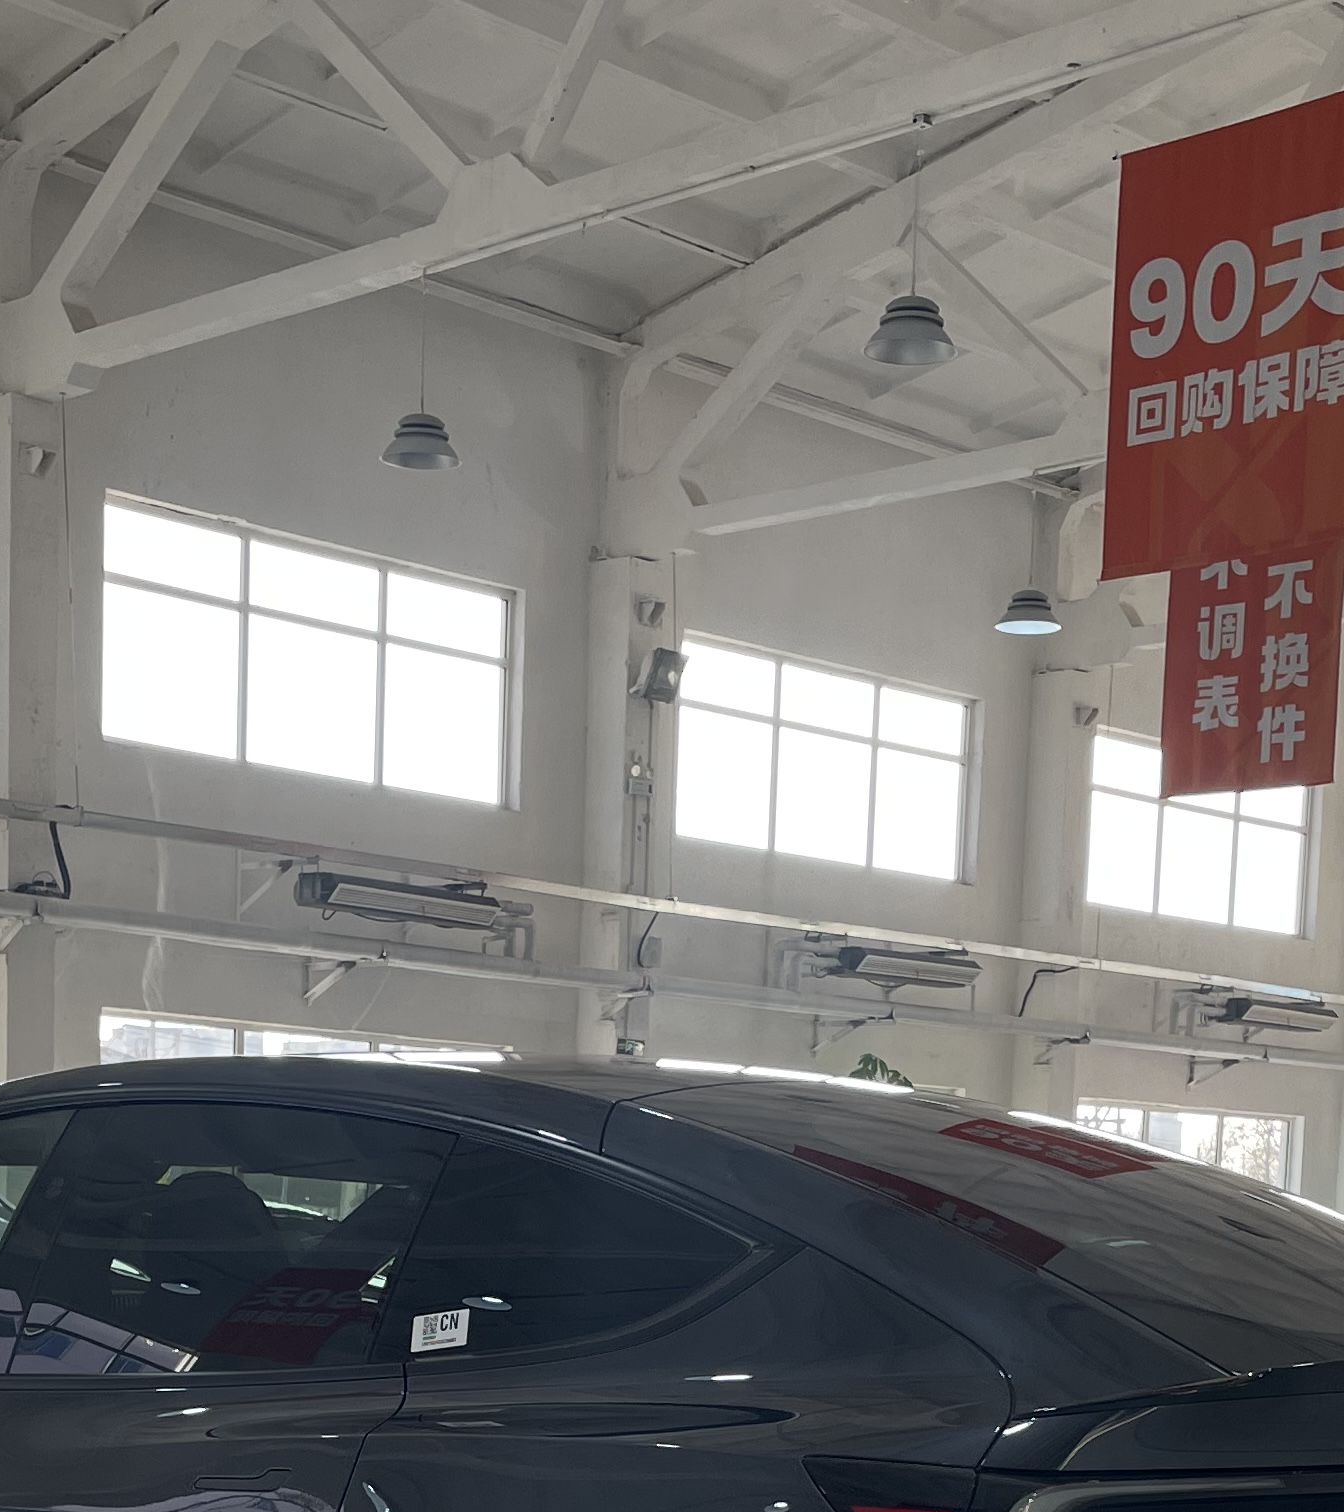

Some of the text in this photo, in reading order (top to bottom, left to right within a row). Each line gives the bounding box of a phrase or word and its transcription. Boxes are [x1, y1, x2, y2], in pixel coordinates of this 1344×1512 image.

[1257, 559, 1314, 764] 不换件
[440, 1312, 460, 1332] CN
